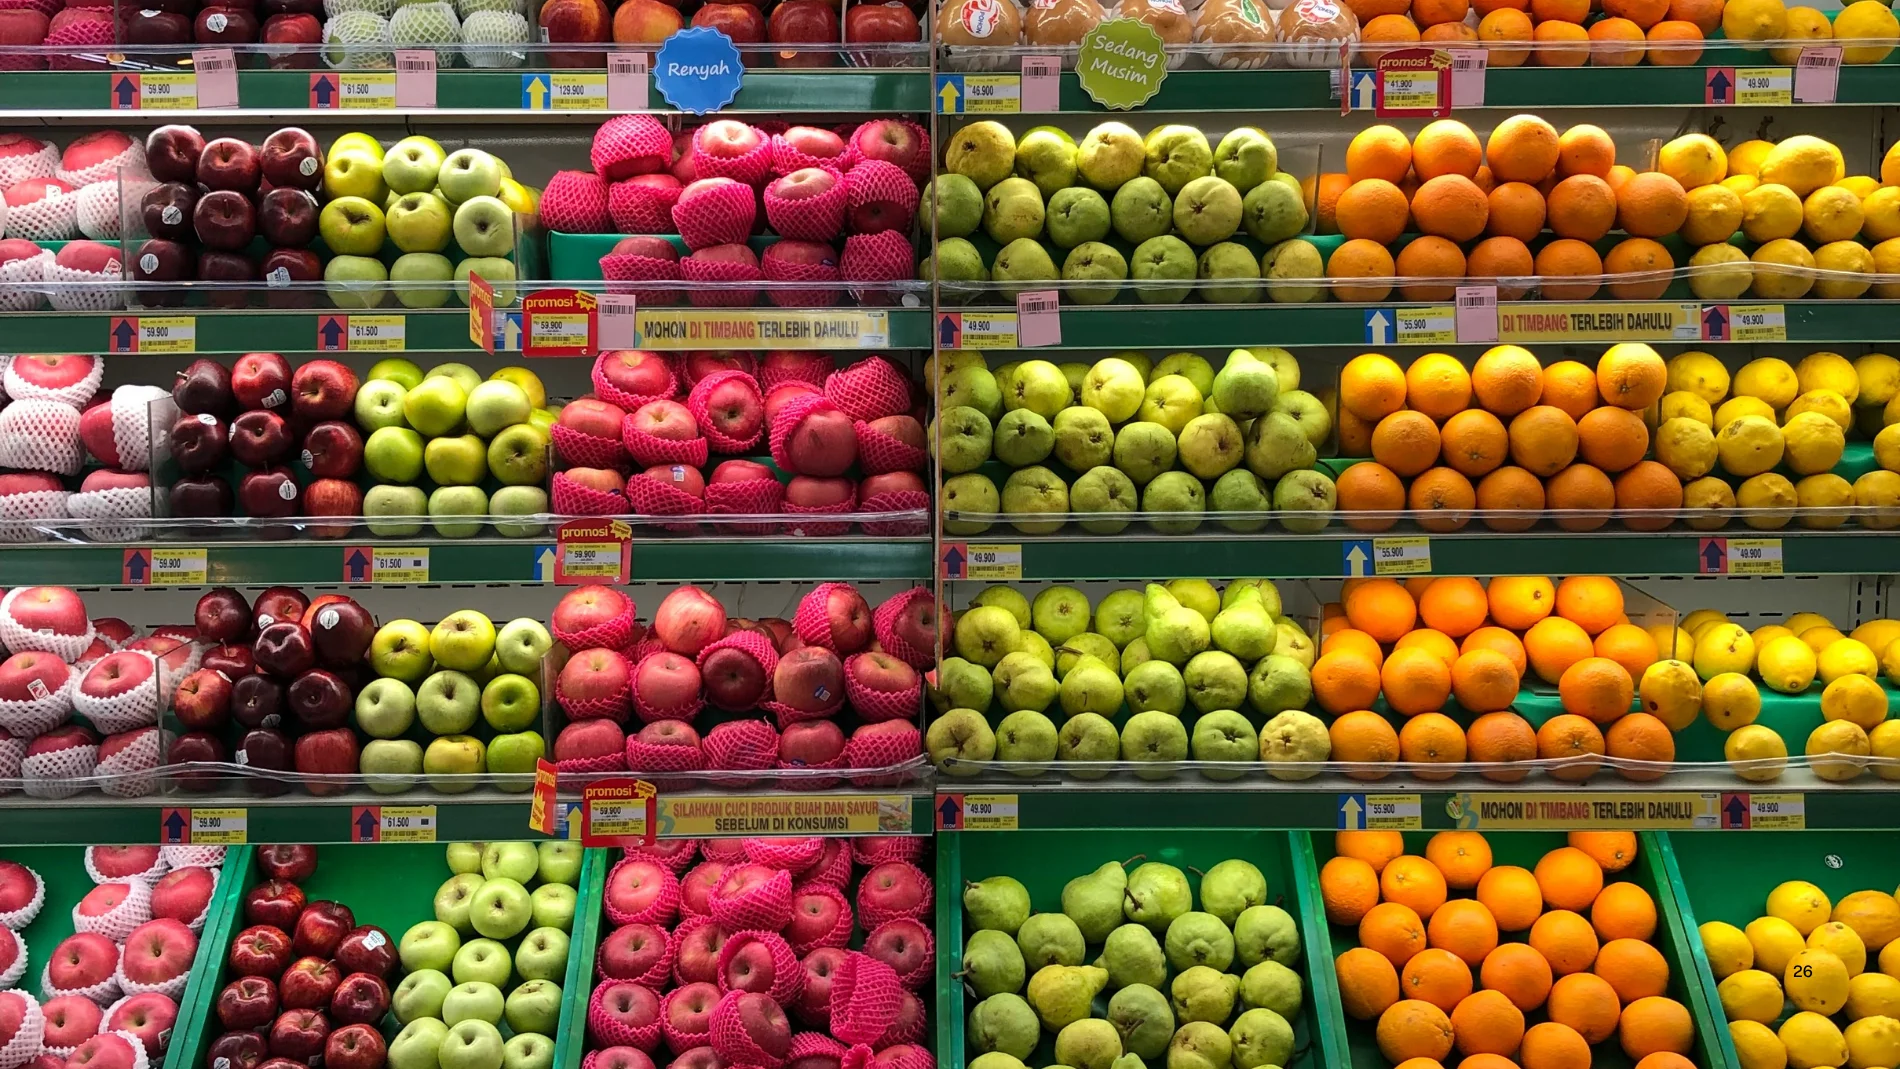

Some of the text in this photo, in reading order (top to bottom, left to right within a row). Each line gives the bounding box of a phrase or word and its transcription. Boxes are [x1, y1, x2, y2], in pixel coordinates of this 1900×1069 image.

[1092, 35, 1158, 68] Sedang
[1379, 57, 1427, 69] promosi
[668, 60, 730, 80] Renyah
[1090, 58, 1147, 85] Musim
[1390, 80, 1413, 89] 41.900
[1748, 77, 1770, 88] 49.900
[148, 83, 170, 95] 59.900
[347, 83, 370, 95] 61.500
[559, 85, 584, 96] 129.900
[972, 85, 994, 96] 46.900
[526, 295, 573, 310] promosi
[1404, 319, 1426, 330] 55.900
[1503, 313, 1672, 333] DI TIMBANG TERLEBIH DAHULU
[1742, 314, 1764, 325] 49.900
[356, 326, 378, 336] 61.500
[540, 321, 562, 330] 59.900
[644, 321, 859, 338] MOHON DI TIMBANG TERLEBIH DAHULU
[968, 321, 990, 332] 49.900
[146, 327, 169, 338] 59.900
[562, 526, 608, 540] promosi
[574, 550, 596, 559] 59.900
[974, 552, 996, 563] 49.900
[1382, 547, 1404, 558] 55.900
[1740, 548, 1762, 559] 49.900
[158, 558, 181, 569] 59.900
[379, 558, 402, 569] 61.500
[586, 785, 632, 800] promosi
[600, 807, 622, 815] 59.900
[673, 801, 879, 817] SILAHKAN CUCI PRODUK BUAH DAN SAYUR
[970, 804, 992, 814] 49.900
[1373, 804, 1396, 814] 55.900
[1481, 801, 1692, 819] MOHON DI TIMBANG TERLEBIH DAHULU
[1756, 802, 1779, 813] 49.900
[198, 817, 221, 828] 59.900
[388, 816, 410, 828] 61.500
[715, 816, 848, 832] SEBELUM DI KONSUMSI
